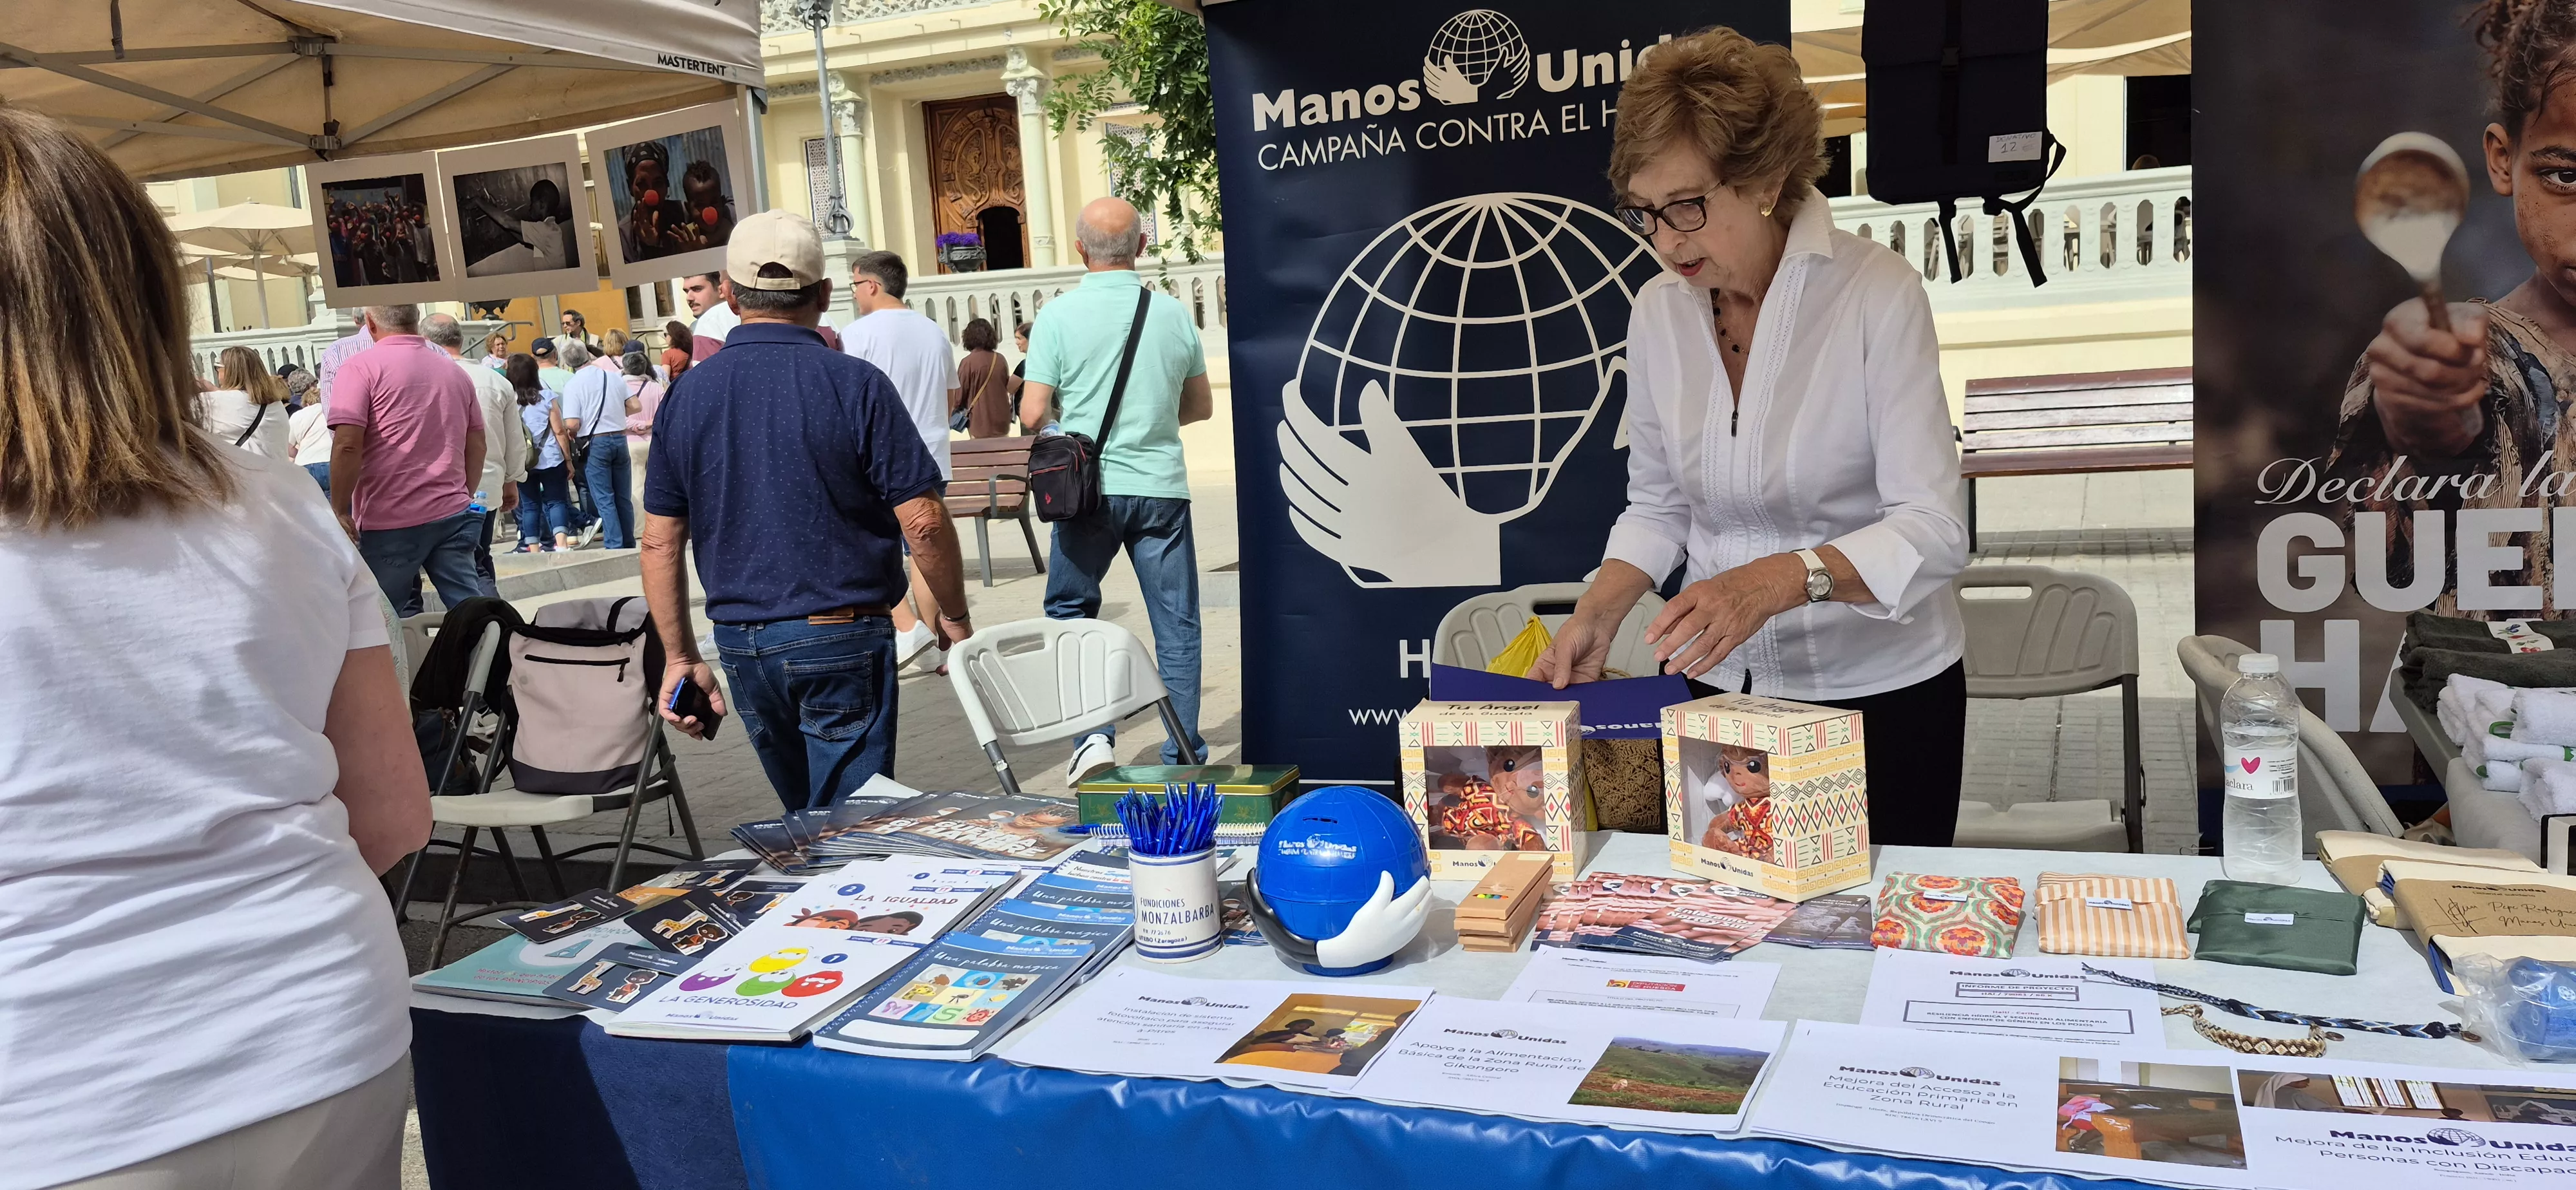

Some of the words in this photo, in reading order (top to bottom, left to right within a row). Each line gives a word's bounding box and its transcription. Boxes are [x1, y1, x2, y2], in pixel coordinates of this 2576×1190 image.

[657, 52, 728, 77] MASTERTENT
[1251, 79, 1421, 132] Manos
[1257, 123, 1406, 171] CAMPAÑA
[1416, 108, 1551, 149] CONTRA
[1562, 103, 1591, 134] EL
[2000, 141, 2018, 154] 12
[2253, 455, 2505, 505] Declara
[2517, 450, 2576, 499] la
[1479, 703, 1540, 712] Ángel
[1740, 708, 1785, 719] Guarda
[1754, 702, 1815, 714] Ángel
[920, 825, 1048, 857] HAMBRE
[934, 820, 1038, 847] GUERRA
[1452, 859, 1479, 868] Manos
[1700, 856, 1721, 869] Manos
[1731, 865, 1754, 878] Unidas
[848, 885, 857, 893] 2
[1032, 890, 1058, 900] Una
[1056, 895, 1105, 904] palabra
[854, 894, 874, 902] LA
[882, 895, 959, 905] IGUALDAD
[1140, 897, 1186, 909] FUNDICIONES
[1141, 902, 1215, 925] MONZALBARBA
[1665, 911, 1709, 923] Norte
[1719, 921, 1751, 930] Sur
[989, 918, 1016, 928] Una
[1014, 923, 1065, 934] palabra
[934, 950, 963, 963] Una
[960, 956, 1012, 968] palabra
[683, 996, 799, 1010] GENEROSIDAD
[1138, 996, 1181, 1005] Manos
[1205, 1001, 1251, 1010] Unidas
[1097, 1016, 1141, 1026] atención
[1142, 1021, 1186, 1030] sanitaria
[1107, 1010, 1165, 1023] fotovoltaico
[1443, 1028, 1490, 1038] Manos
[1517, 1035, 1567, 1044] Unidas
[1397, 1048, 1444, 1059] Básica
[1483, 1057, 1521, 1066] Zona
[1524, 1061, 1564, 1070] Rural
[1409, 1041, 1455, 1052] Apoyo
[1484, 1049, 1582, 1064] Alimentación
[1443, 1062, 1520, 1074] Gikongoro
[1839, 1065, 1899, 1077] Manos
[1935, 1073, 2002, 1087] Unidas
[1823, 1081, 1911, 1097] Educación
[1917, 1091, 1991, 1106] Primaria
[1995, 1100, 2018, 1108] en
[1828, 1074, 1885, 1086] Mejora
[1889, 1080, 1916, 1090] del
[1919, 1084, 1982, 1096] Acceso
[2002, 1091, 2016, 1100] la
[1870, 1095, 1913, 1106] Zona
[1918, 1100, 1965, 1111] Rural
[2328, 1129, 2429, 1146] Manos
[2275, 1135, 2346, 1149] Mejora
[2352, 1138, 2380, 1151] de
[2385, 1143, 2404, 1153] la
[2410, 1146, 2511, 1160] Inclusión
[2318, 1149, 2420, 1166] Personas
[2425, 1160, 2468, 1169] con
